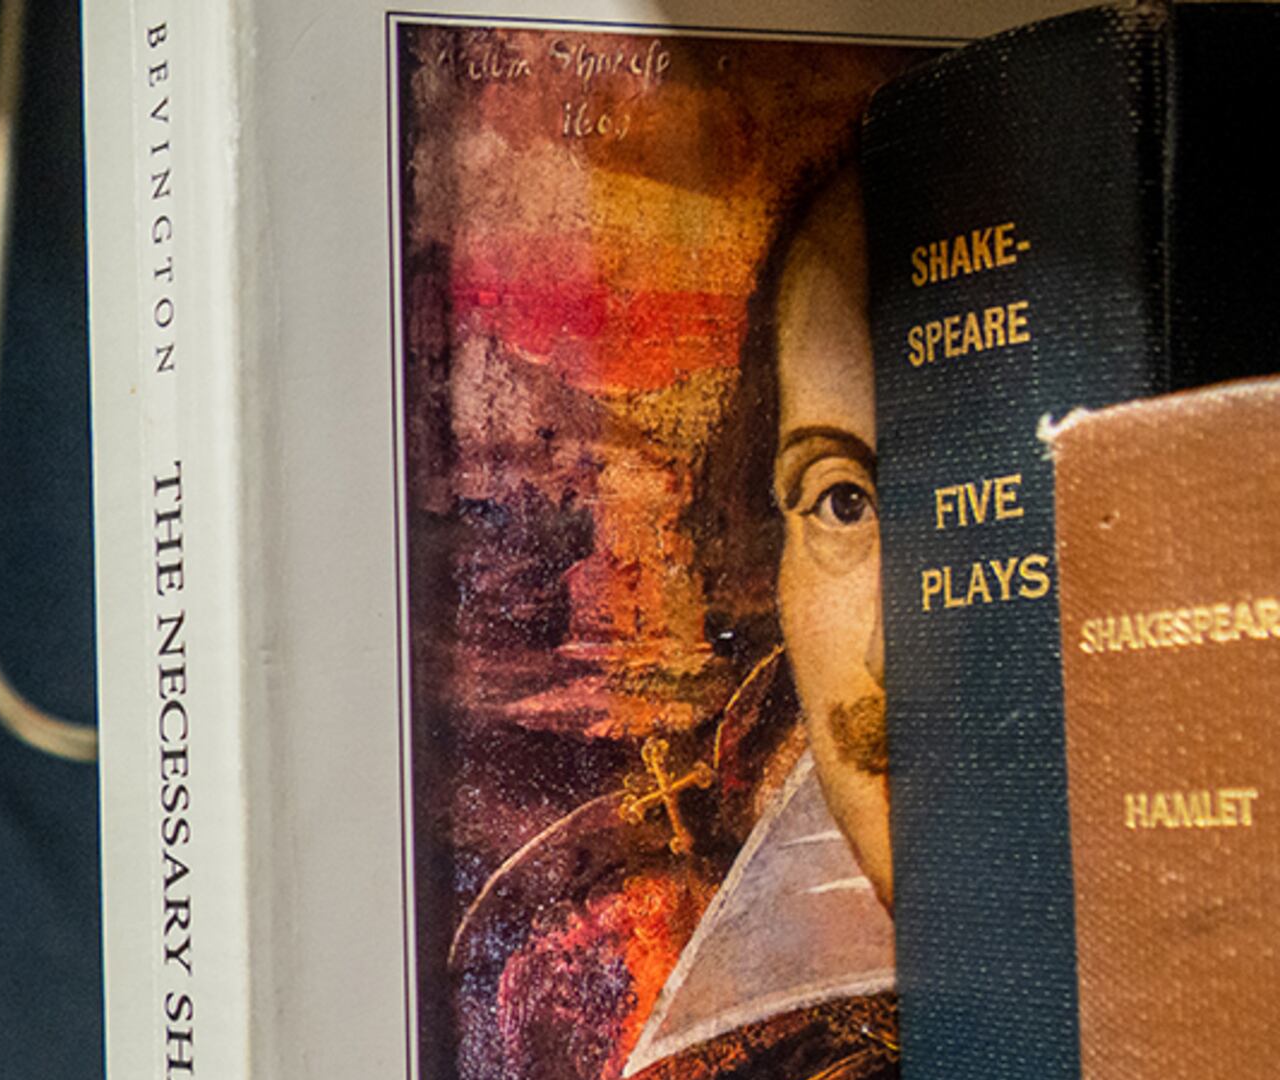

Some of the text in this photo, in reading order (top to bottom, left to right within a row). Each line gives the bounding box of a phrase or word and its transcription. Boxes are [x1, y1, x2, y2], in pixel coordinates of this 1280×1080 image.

[146, 22, 176, 374] BEVINGTON
[911, 222, 1031, 287] SHAKE-
[908, 301, 1032, 367] SPEARE
[153, 460, 185, 597] THE
[934, 473, 1025, 530] FIVE
[921, 553, 1051, 612] PLAYS
[156, 609, 194, 976] NECESSARY
[1124, 787, 1259, 830] HAMLET
